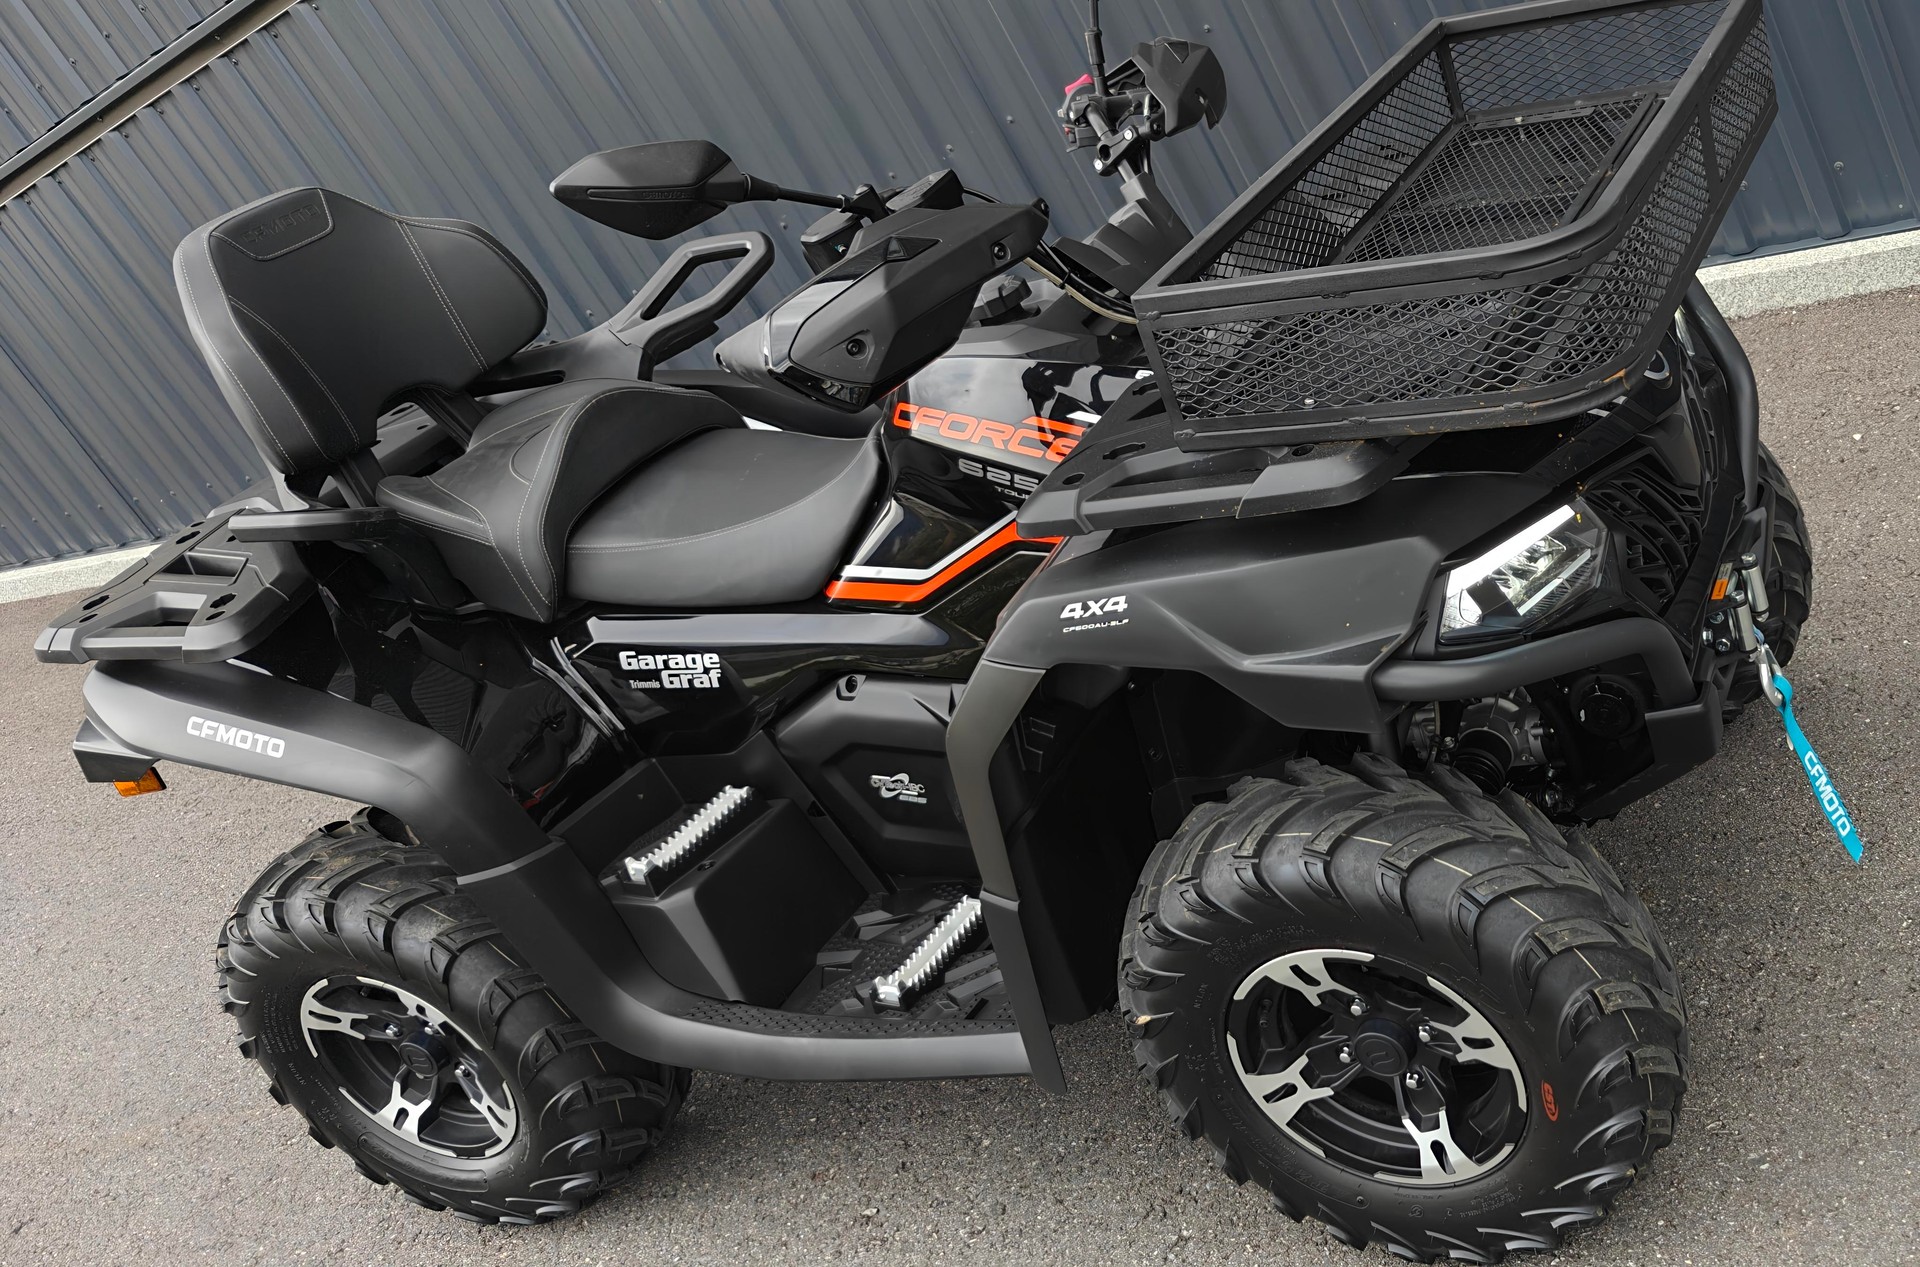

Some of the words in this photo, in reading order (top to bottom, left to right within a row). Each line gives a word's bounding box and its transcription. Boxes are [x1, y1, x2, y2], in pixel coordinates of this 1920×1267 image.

[893, 402, 1086, 463] CFORCE
[958, 458, 1040, 492] 625
[619, 651, 720, 674] Garage
[629, 679, 661, 689] Trimmis
[661, 669, 721, 689] Graf
[186, 716, 286, 759] CFMOTO
[1804, 751, 1851, 837] CFMOTO
